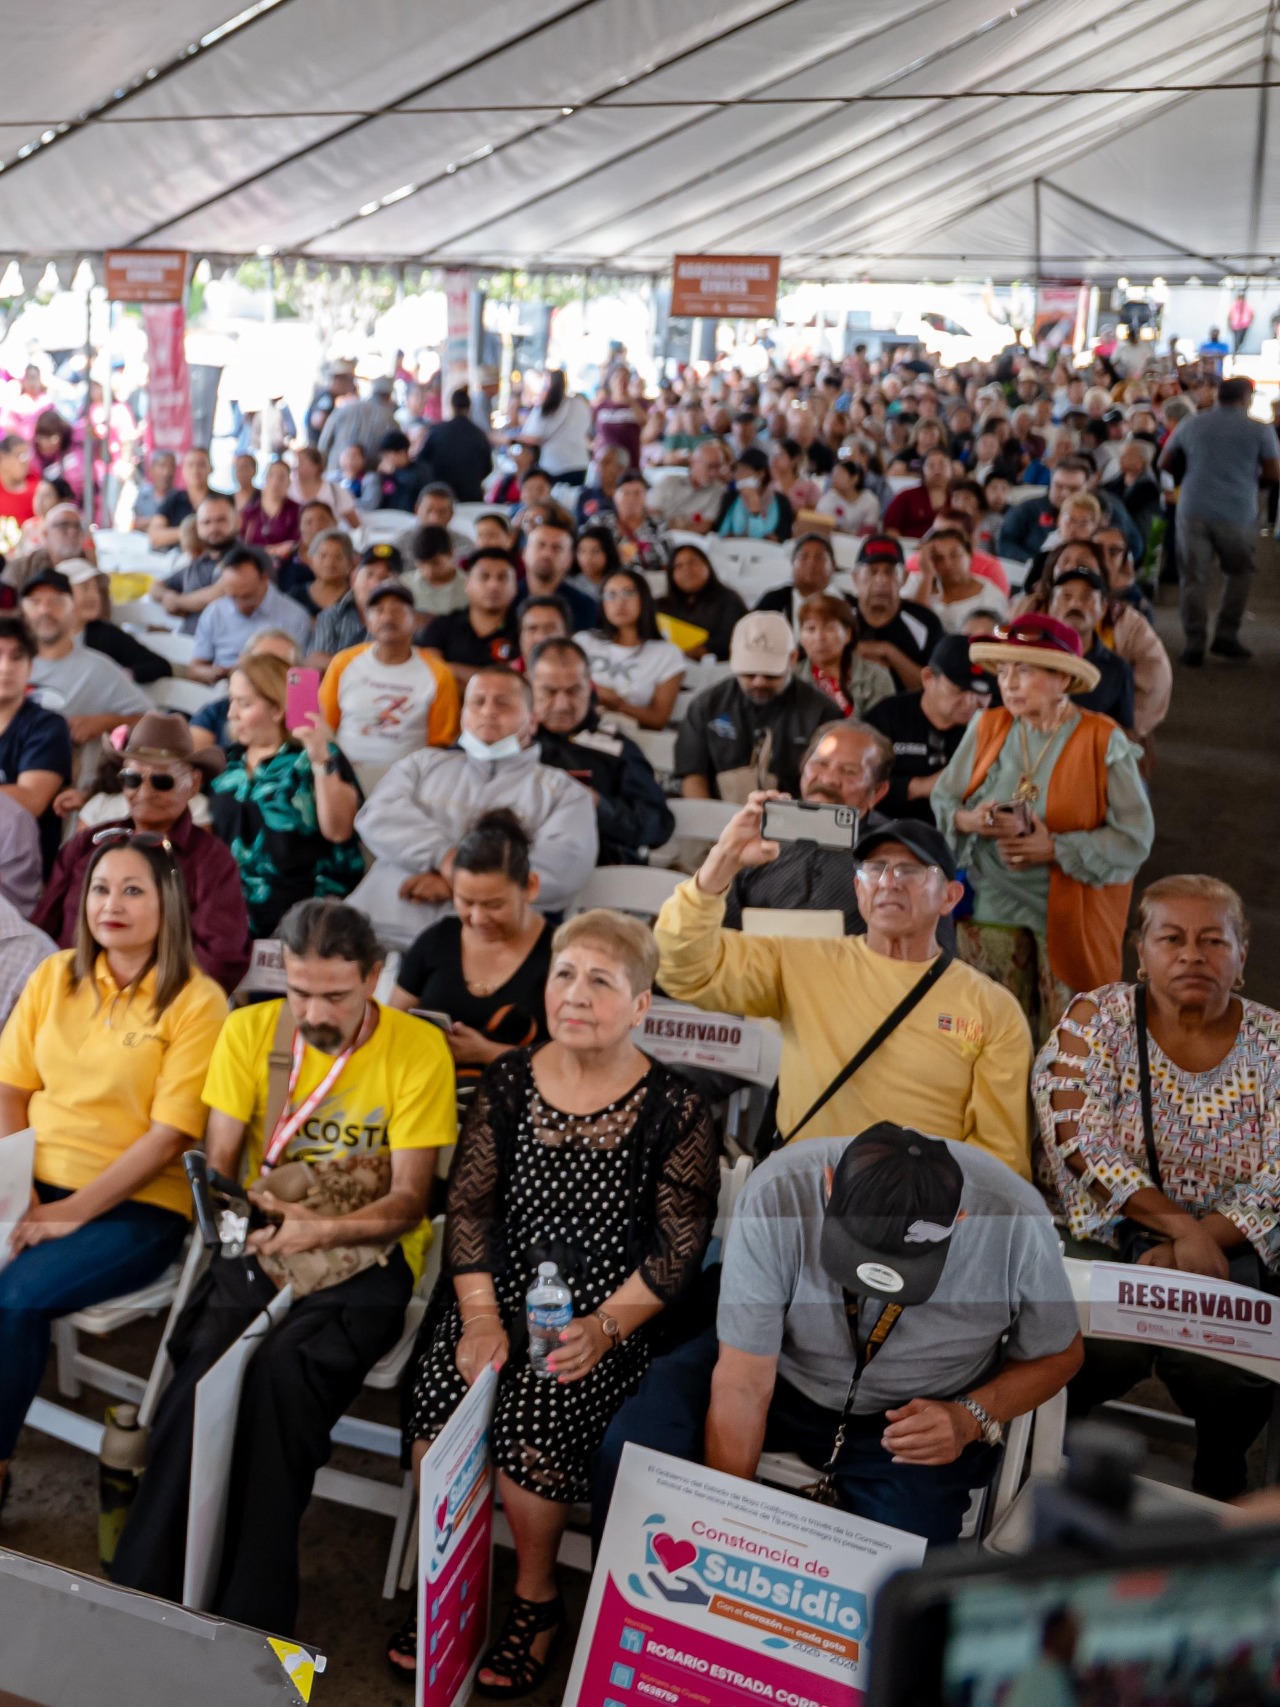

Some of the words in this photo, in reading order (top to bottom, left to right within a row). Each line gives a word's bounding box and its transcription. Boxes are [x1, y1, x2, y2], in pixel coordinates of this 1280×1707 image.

[644, 1017, 742, 1046] RESERVADO
[297, 1117, 390, 1149] COST
[1118, 1280, 1273, 1326] RESERVADO
[691, 1520, 799, 1569] Constancia
[804, 1559, 830, 1578] de
[702, 1552, 862, 1631] Subsidio
[715, 1599, 734, 1613] Con
[734, 1607, 743, 1616] el
[742, 1609, 783, 1630] corazón
[782, 1625, 795, 1634] en
[795, 1628, 822, 1644] cada
[821, 1638, 847, 1653] gota
[644, 1639, 710, 1673] ROSARIO
[708, 1663, 776, 1697] ESTRADA
